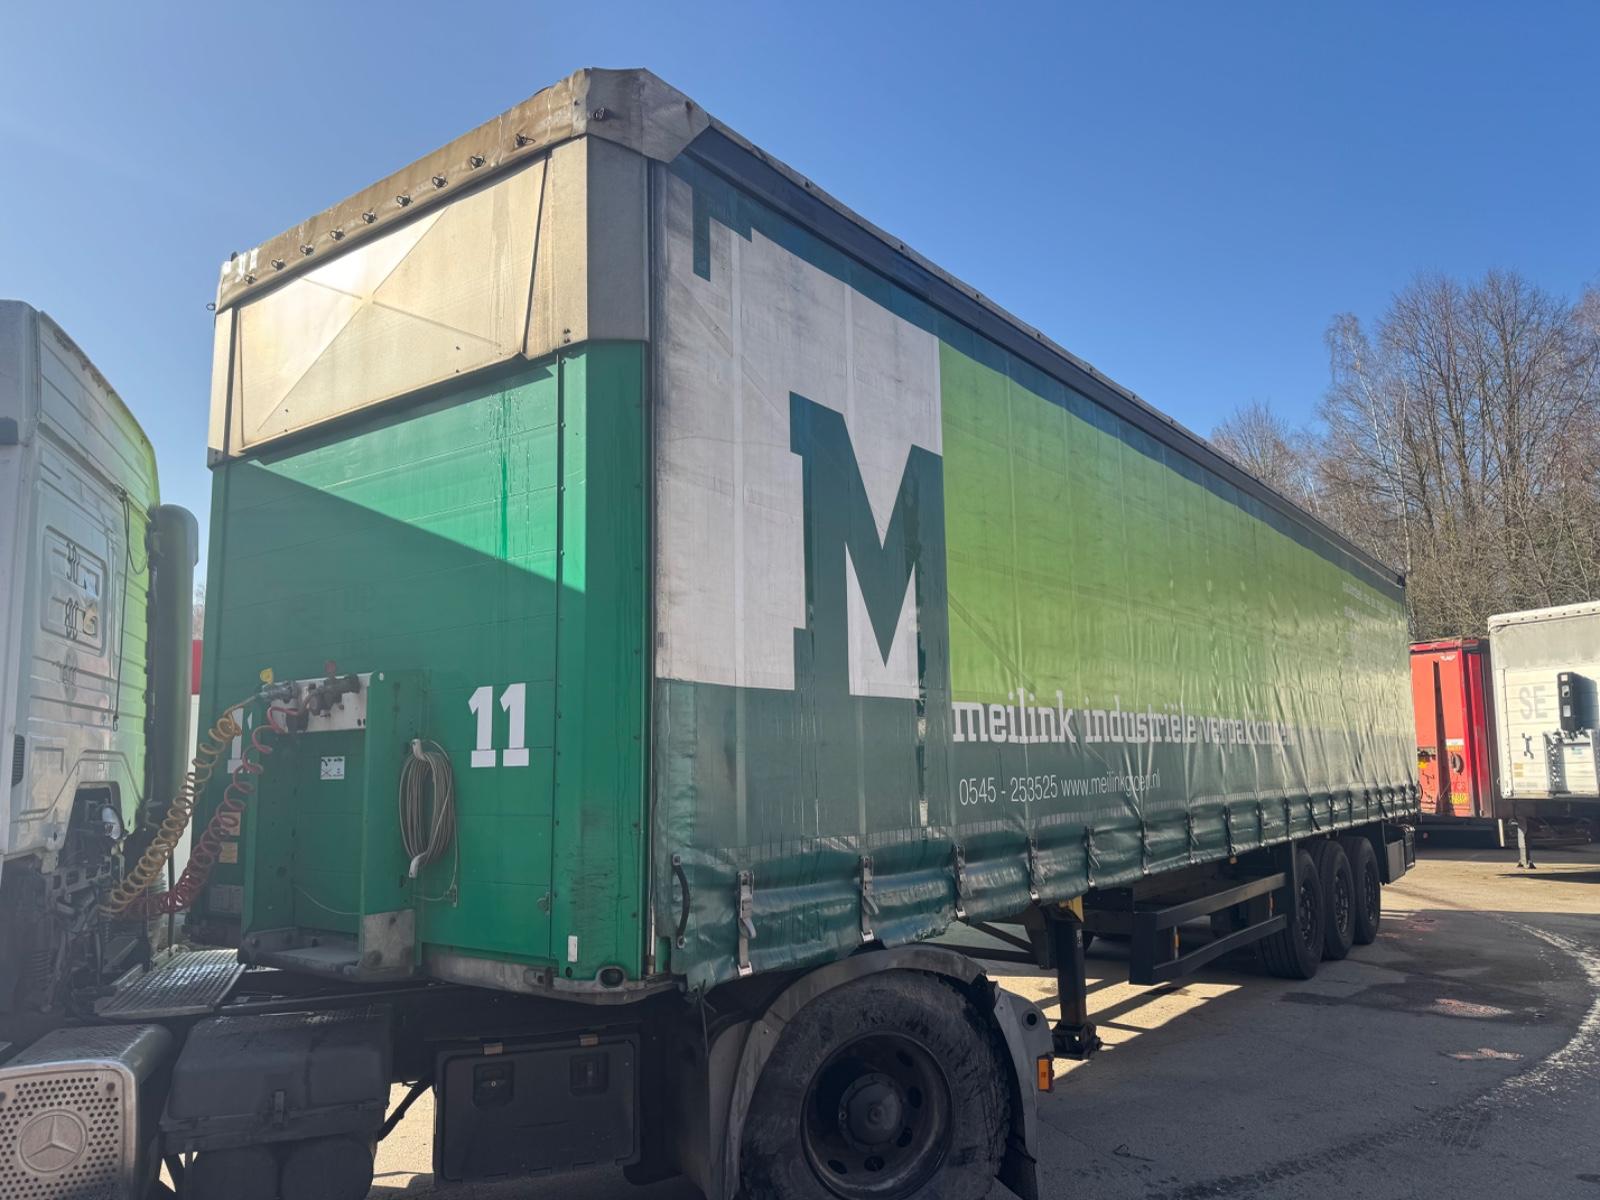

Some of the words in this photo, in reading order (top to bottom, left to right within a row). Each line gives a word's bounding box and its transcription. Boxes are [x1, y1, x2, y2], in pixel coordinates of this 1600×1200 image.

[951, 687, 1077, 744] meilink
[1083, 693, 1197, 744] industriële
[1520, 685, 1548, 719] SE
[468, 683, 529, 767] 11
[959, 777, 997, 806] 0545
[1010, 774, 1058, 802] 253525
